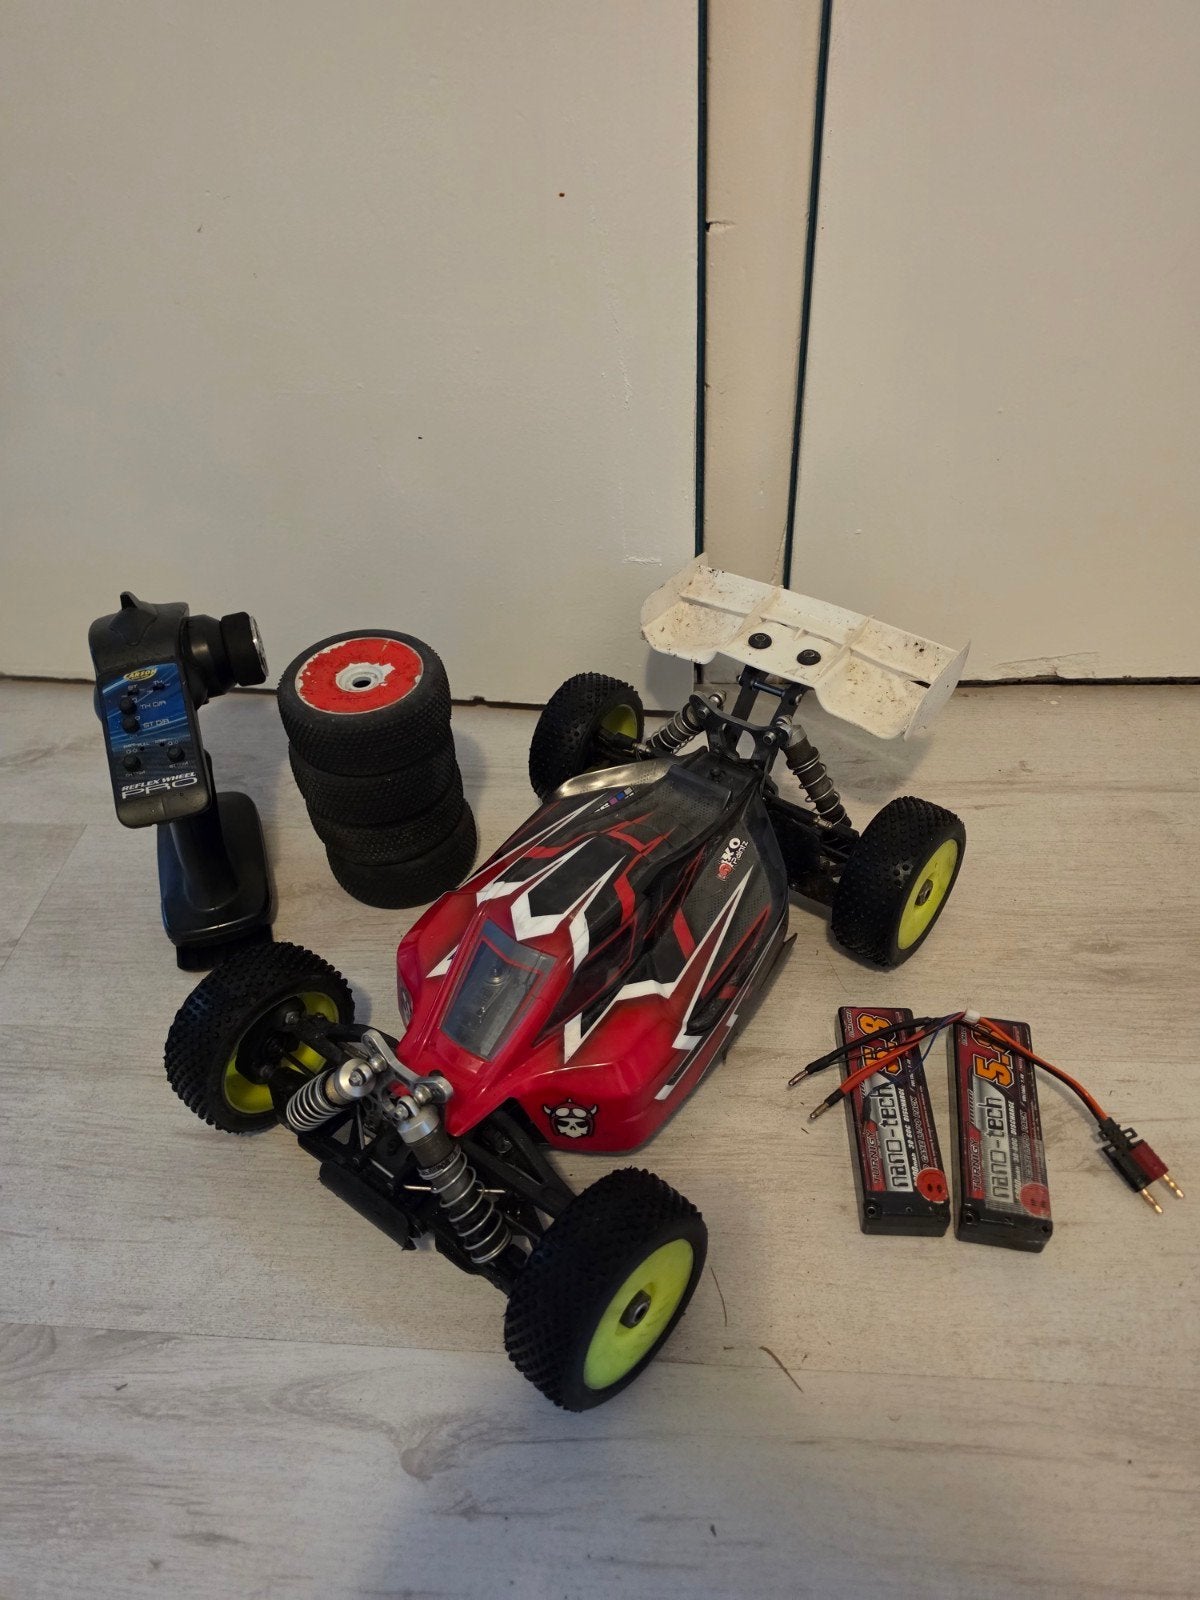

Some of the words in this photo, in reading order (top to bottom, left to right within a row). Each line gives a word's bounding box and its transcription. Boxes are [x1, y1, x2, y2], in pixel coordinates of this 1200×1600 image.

[122, 778, 160, 792] REFLEX
[161, 772, 197, 784] WHEEL
[122, 777, 198, 800] PRO
[870, 1084, 908, 1188] nano-tech
[1007, 1100, 1017, 1135] DISCHARGE
[865, 1128, 880, 1183] TURNIGY
[969, 1137, 981, 1190] TURNIGY
[977, 1096, 1012, 1200] nano-tech
